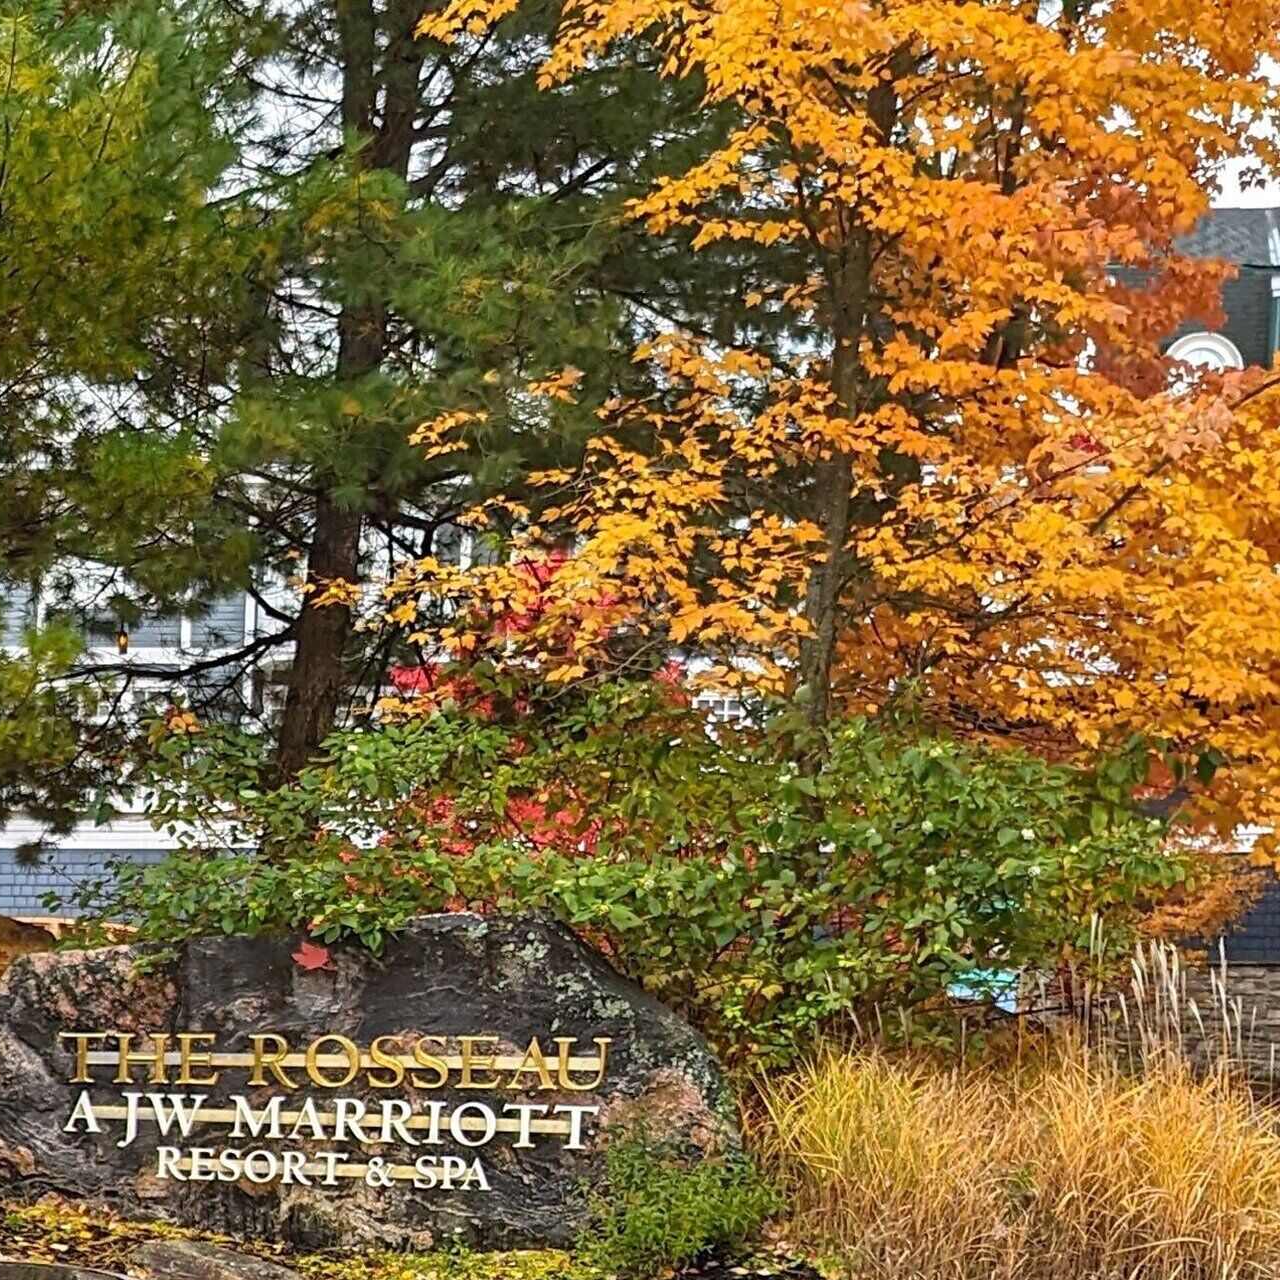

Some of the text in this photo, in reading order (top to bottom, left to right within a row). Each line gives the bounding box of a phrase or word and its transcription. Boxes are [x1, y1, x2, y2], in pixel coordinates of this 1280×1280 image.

[58, 1031, 613, 1091] THE ROSSEAU
[63, 1089, 600, 1149] A JW MARRIOTT
[155, 1146, 492, 1191] RESORT & SPA
